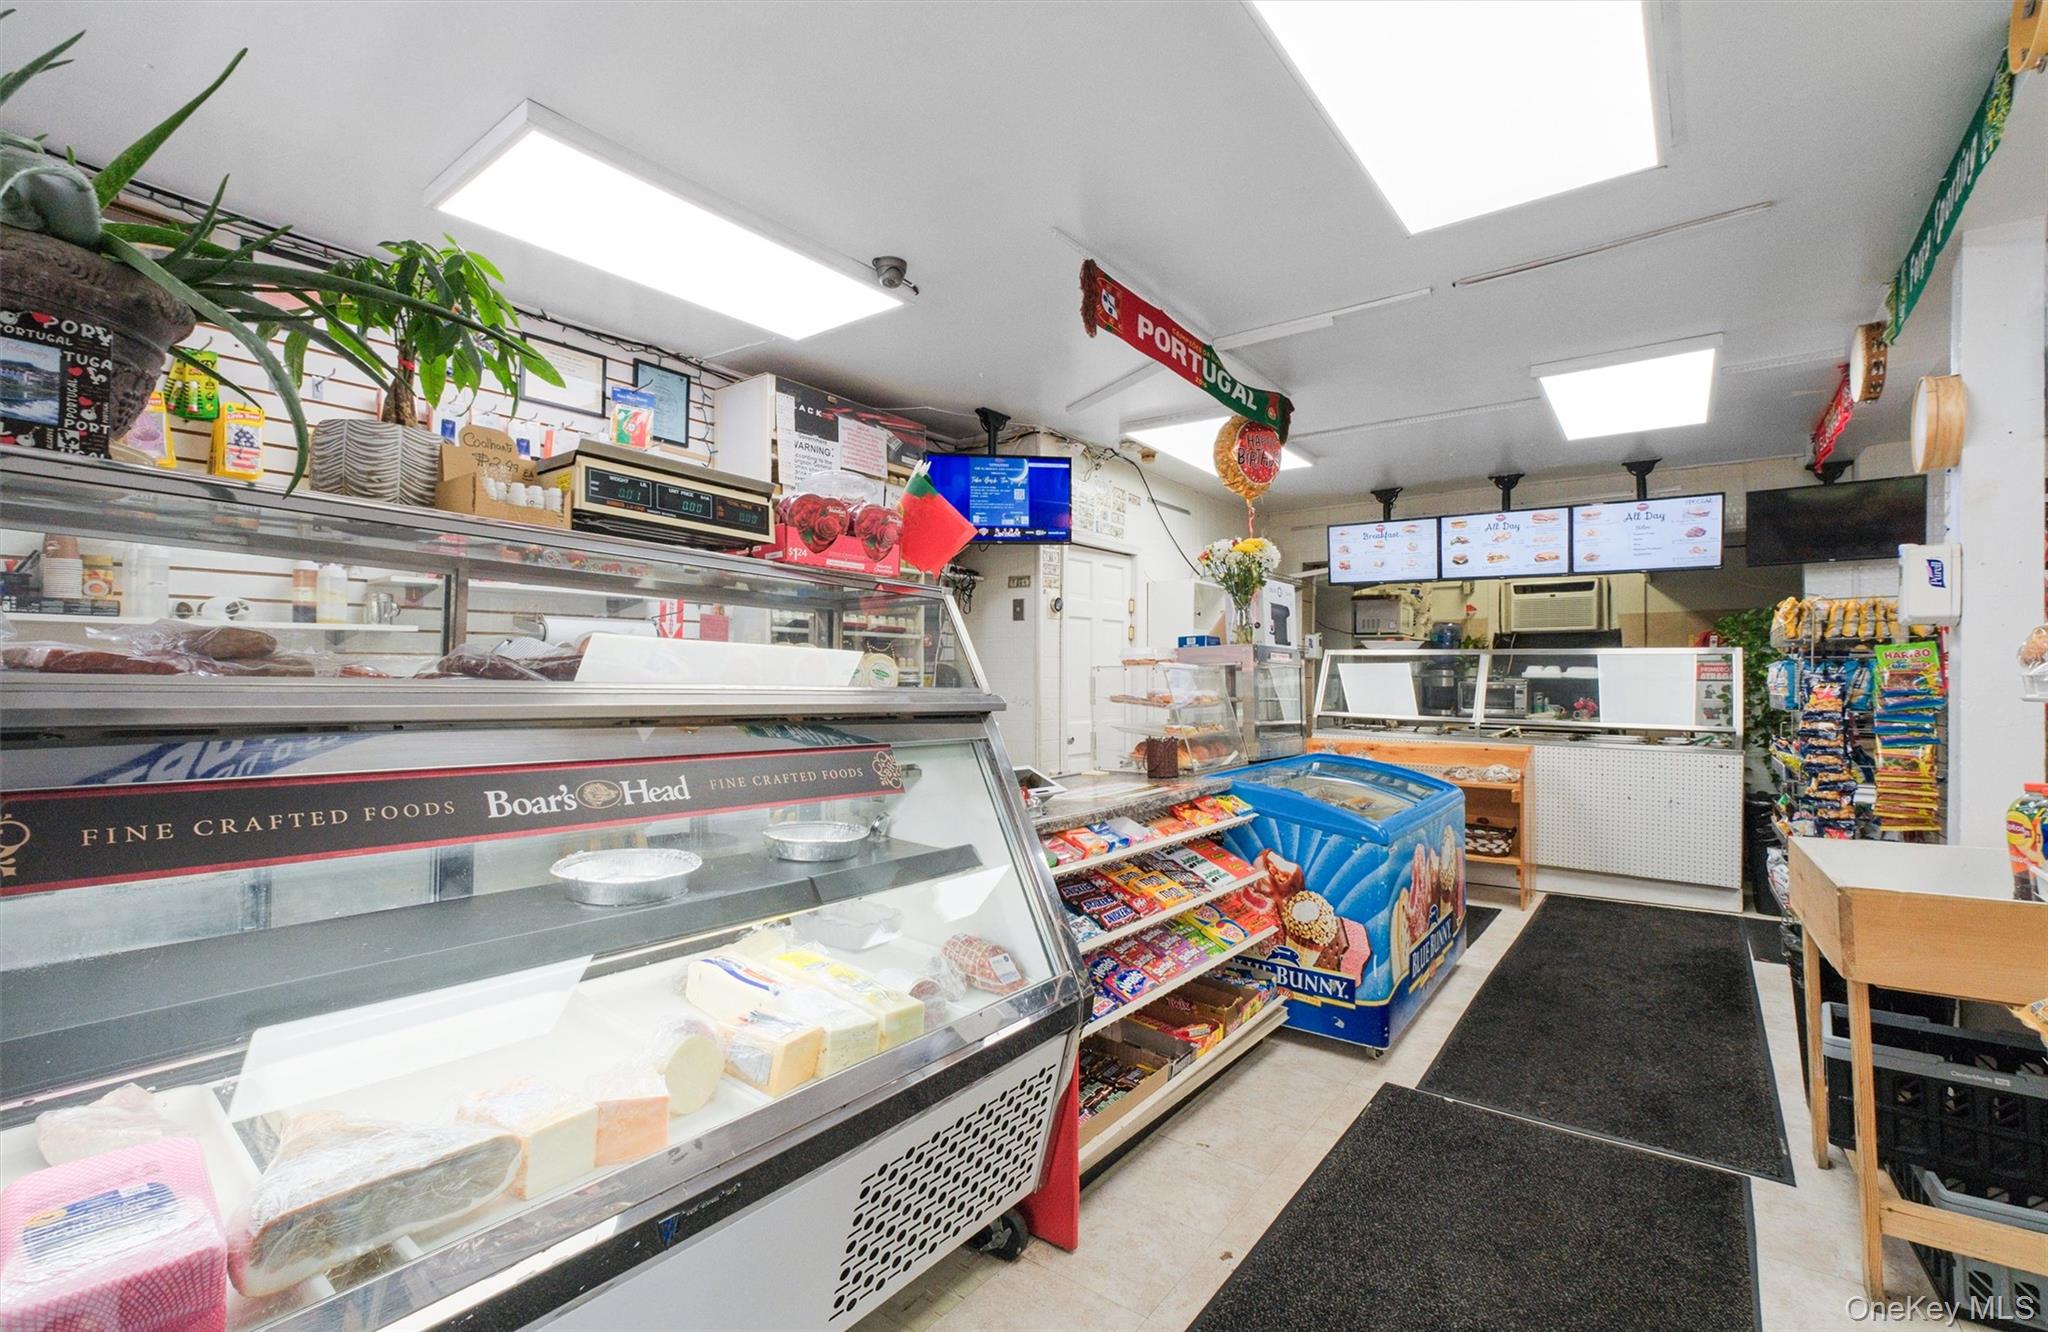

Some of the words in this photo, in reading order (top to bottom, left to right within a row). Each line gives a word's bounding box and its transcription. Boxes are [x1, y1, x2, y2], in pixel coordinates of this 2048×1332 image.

[63, 351, 113, 371] TUGA
[1137, 314, 1257, 411] PORTUGAL
[66, 379, 78, 419] PORTUGAL
[795, 404, 822, 417] ACK
[64, 419, 111, 435] PORT
[1623, 512, 1641, 522] All
[1645, 511, 1666, 521] Day
[1362, 530, 1400, 541] Breakfast
[1484, 522, 1499, 532] All
[1502, 522, 1520, 534] Day
[710, 775, 748, 791] FINE
[752, 769, 816, 788] CRAFTED
[822, 767, 864, 780] FOODS
[482, 784, 580, 820] Boar's
[620, 775, 691, 805] Head
[80, 823, 175, 847] FINE
[193, 808, 349, 837] CRAFTED
[364, 800, 457, 822] FOODS
[1412, 941, 1430, 979] BLUE
[1430, 917, 1453, 959] BUNNY
